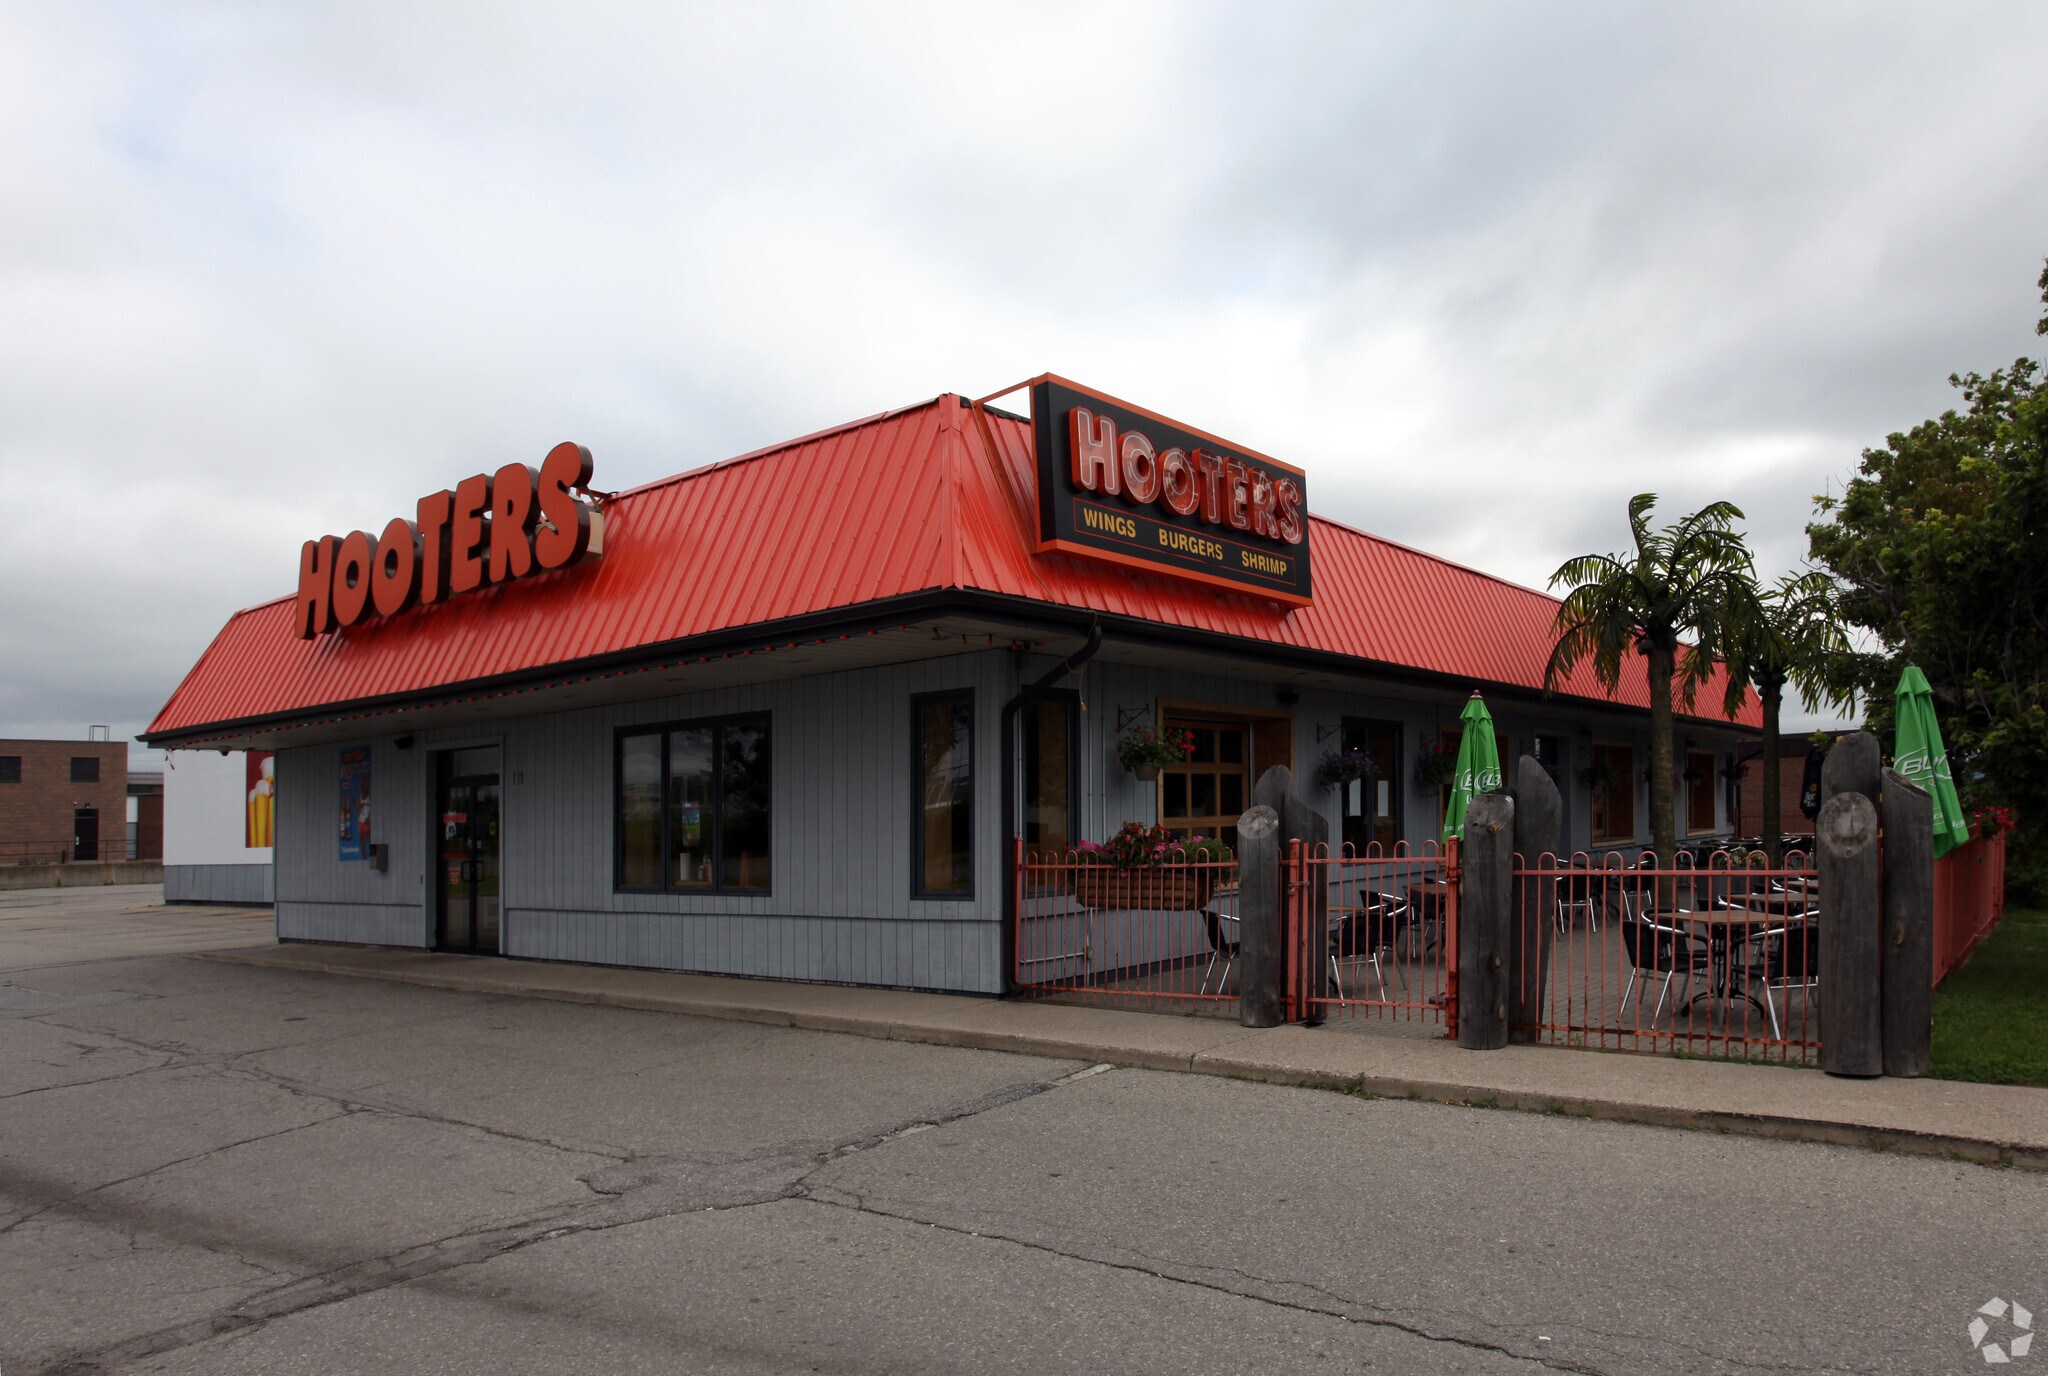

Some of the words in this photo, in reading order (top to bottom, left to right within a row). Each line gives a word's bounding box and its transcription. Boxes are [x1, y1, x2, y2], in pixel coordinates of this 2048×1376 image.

[296, 441, 594, 639] HOOTERS
[1069, 406, 1303, 544] HOOTERS
[1083, 508, 1137, 538] WINGS
[1158, 528, 1224, 561] BURGERS
[1241, 551, 1288, 577] SHRIMP
